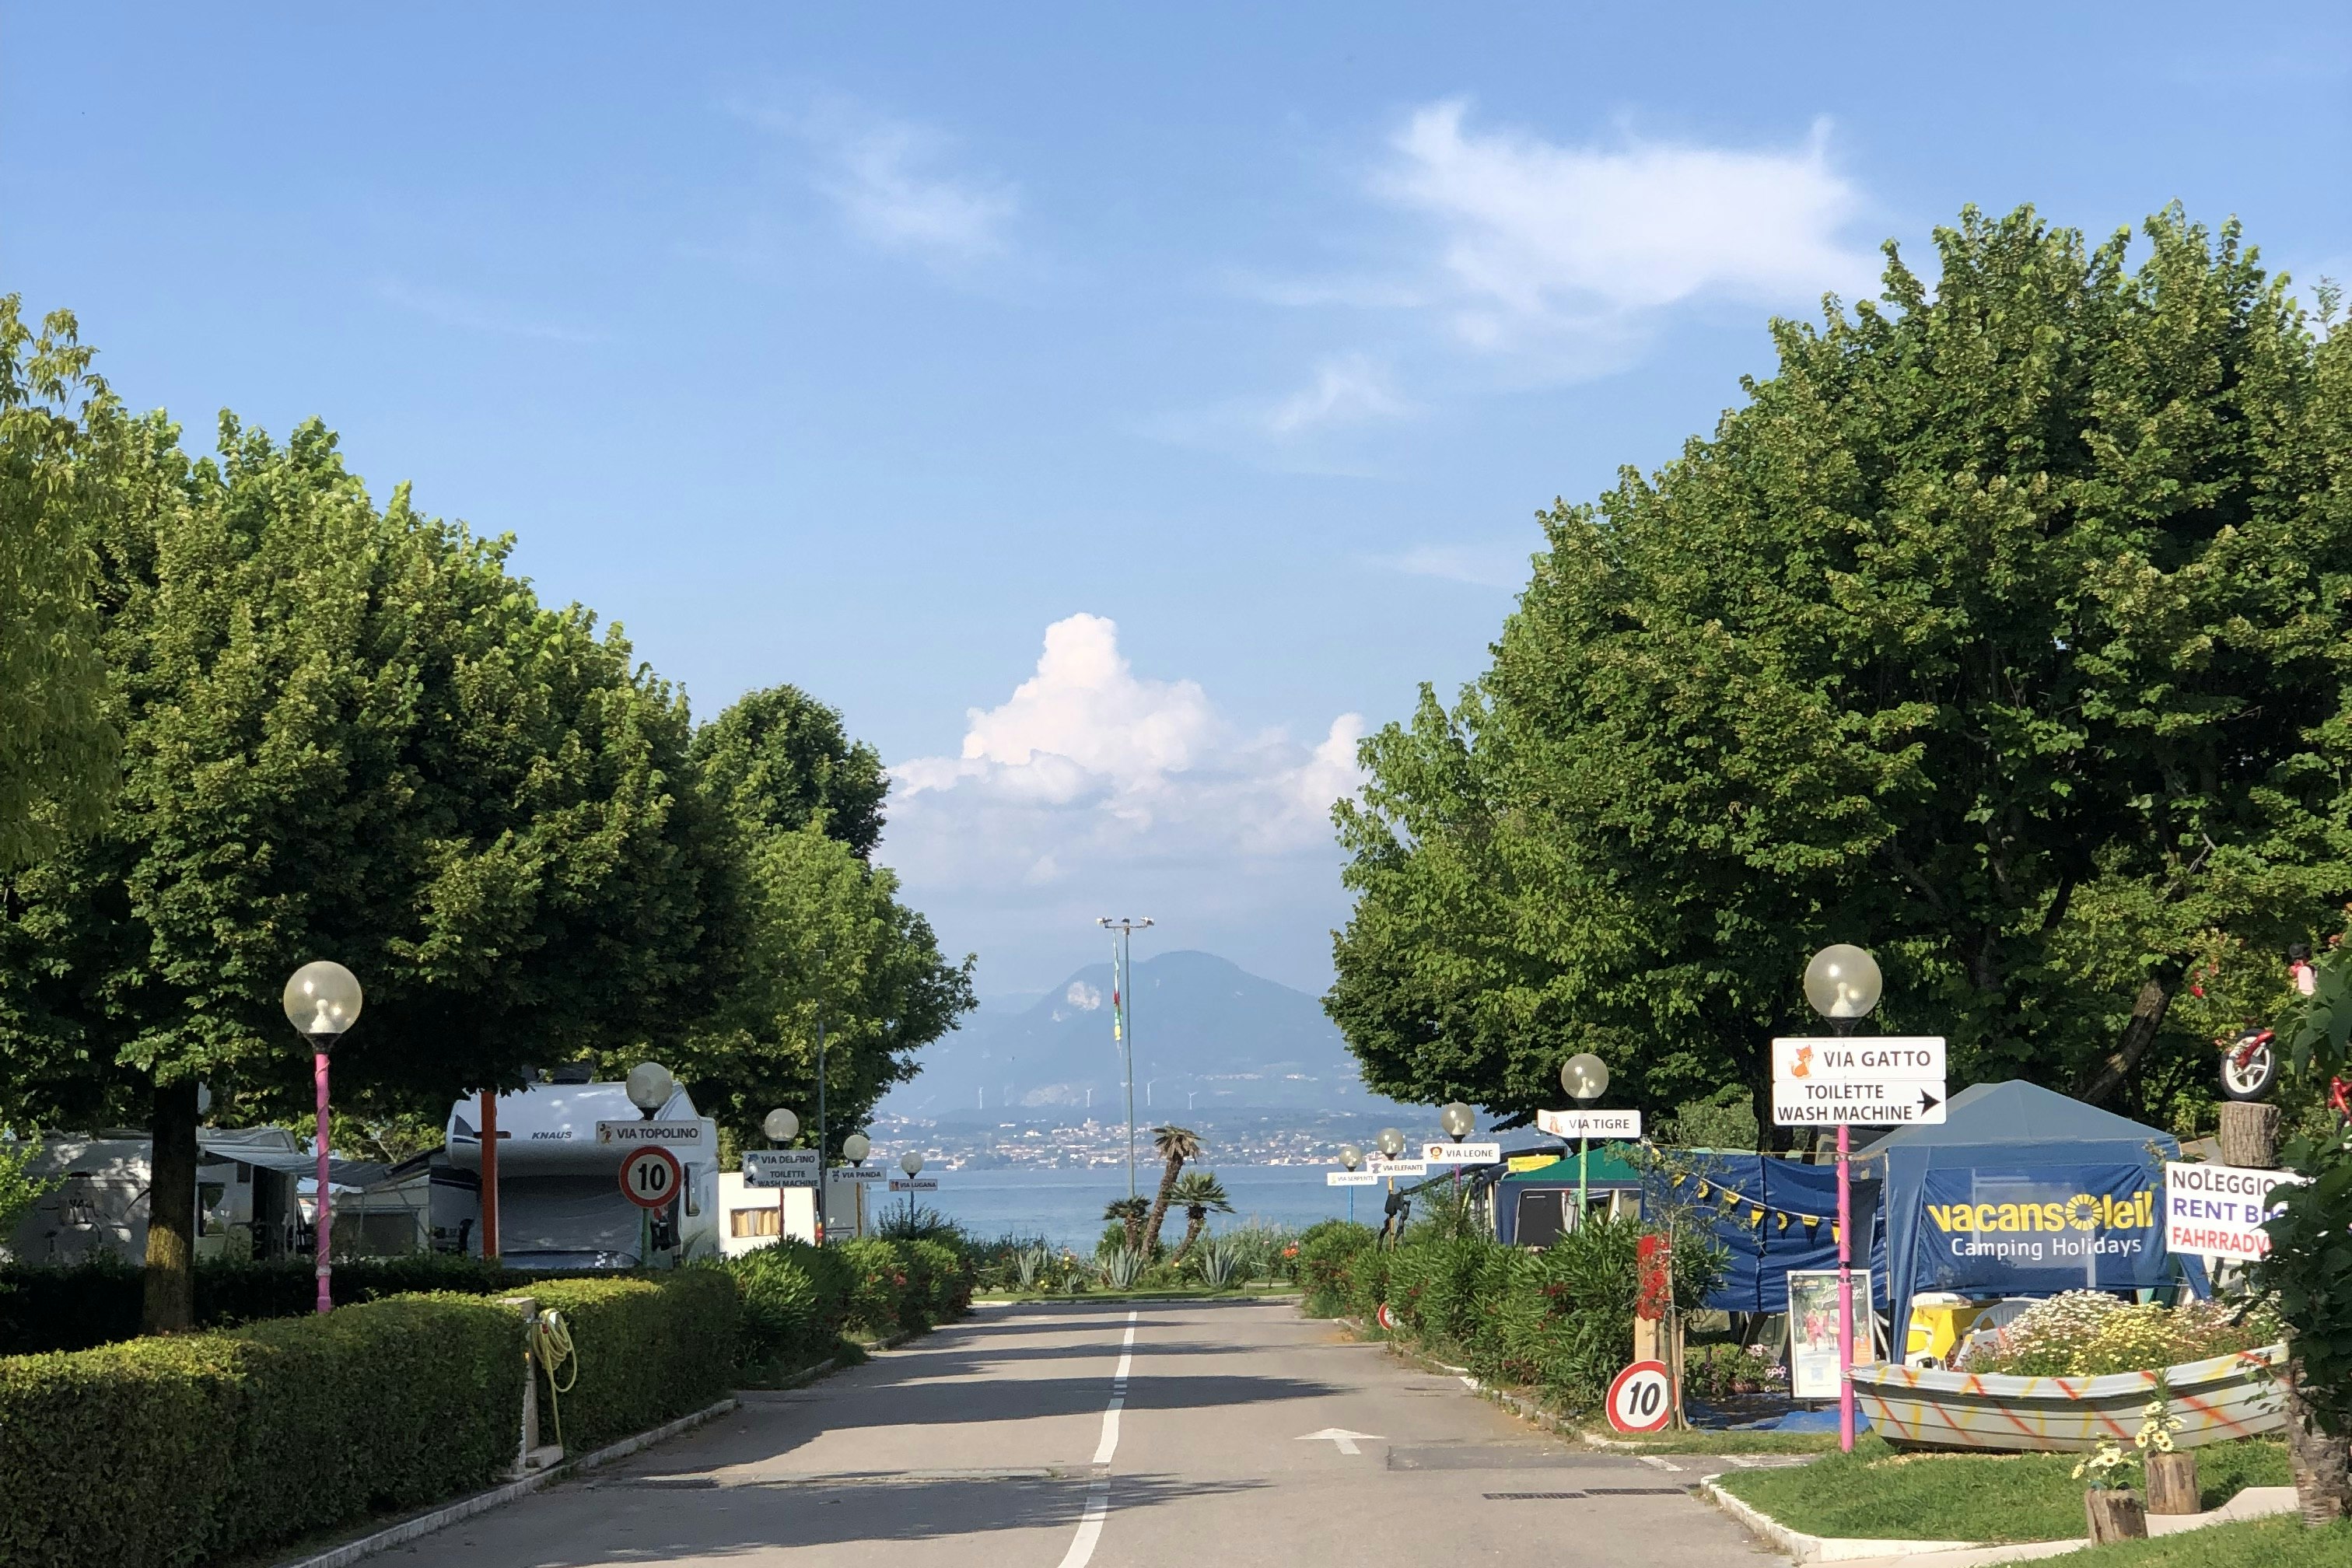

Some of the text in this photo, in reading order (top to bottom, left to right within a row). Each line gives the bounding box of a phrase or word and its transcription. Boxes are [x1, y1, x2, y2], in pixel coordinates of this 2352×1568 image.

[1824, 1050, 1930, 1067] VIA GATTO
[1805, 1084, 1884, 1099] TOILETTE
[1778, 1105, 1913, 1121] WASH MACHINE
[1570, 1118, 1630, 1129] VIA TIGRE
[531, 1131, 572, 1139] KNAUS
[617, 1128, 698, 1139] VIA TOPOLINO
[761, 1155, 816, 1164] VIA DELFINO
[638, 1163, 666, 1191] 10
[769, 1170, 806, 1178] TOILETTE
[2173, 1197, 2238, 1221] RENT
[1951, 1237, 2142, 1261] Camping Holidays
[2172, 1227, 2274, 1255] FAHRRADV
[1629, 1381, 1661, 1416] 10
